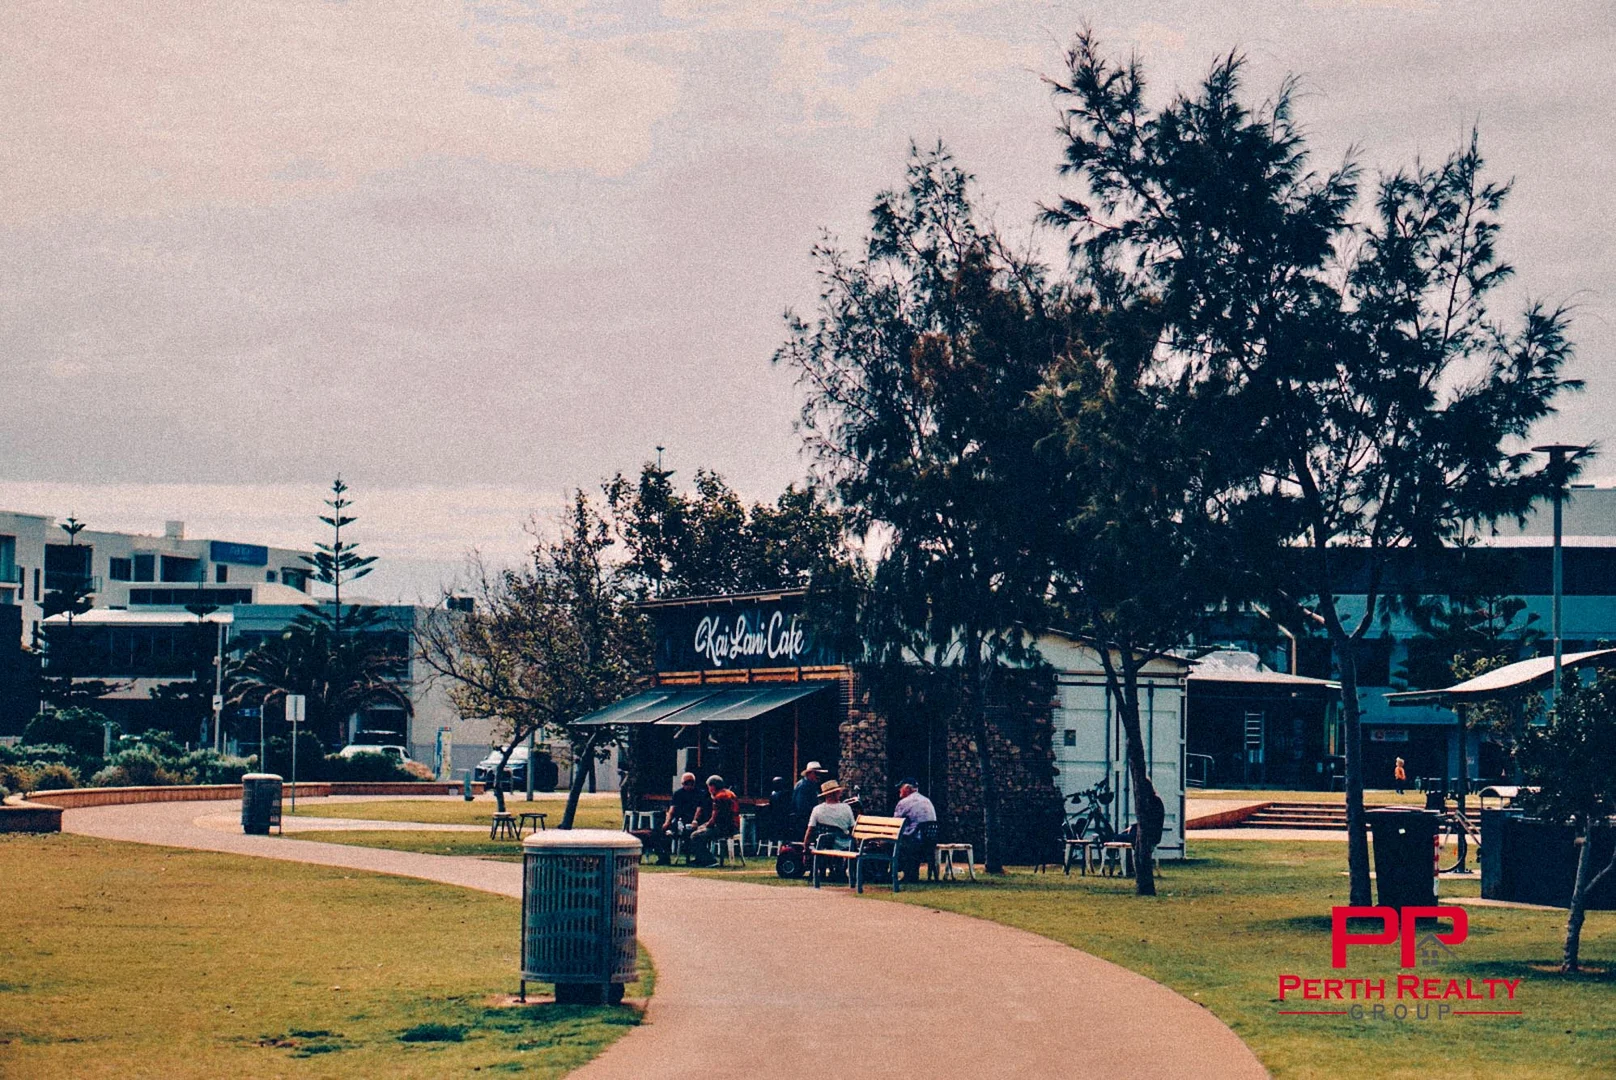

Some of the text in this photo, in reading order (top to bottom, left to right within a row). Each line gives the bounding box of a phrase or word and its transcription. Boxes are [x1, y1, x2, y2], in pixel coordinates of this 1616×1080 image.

[694, 610, 805, 667] Kai Lani Café
